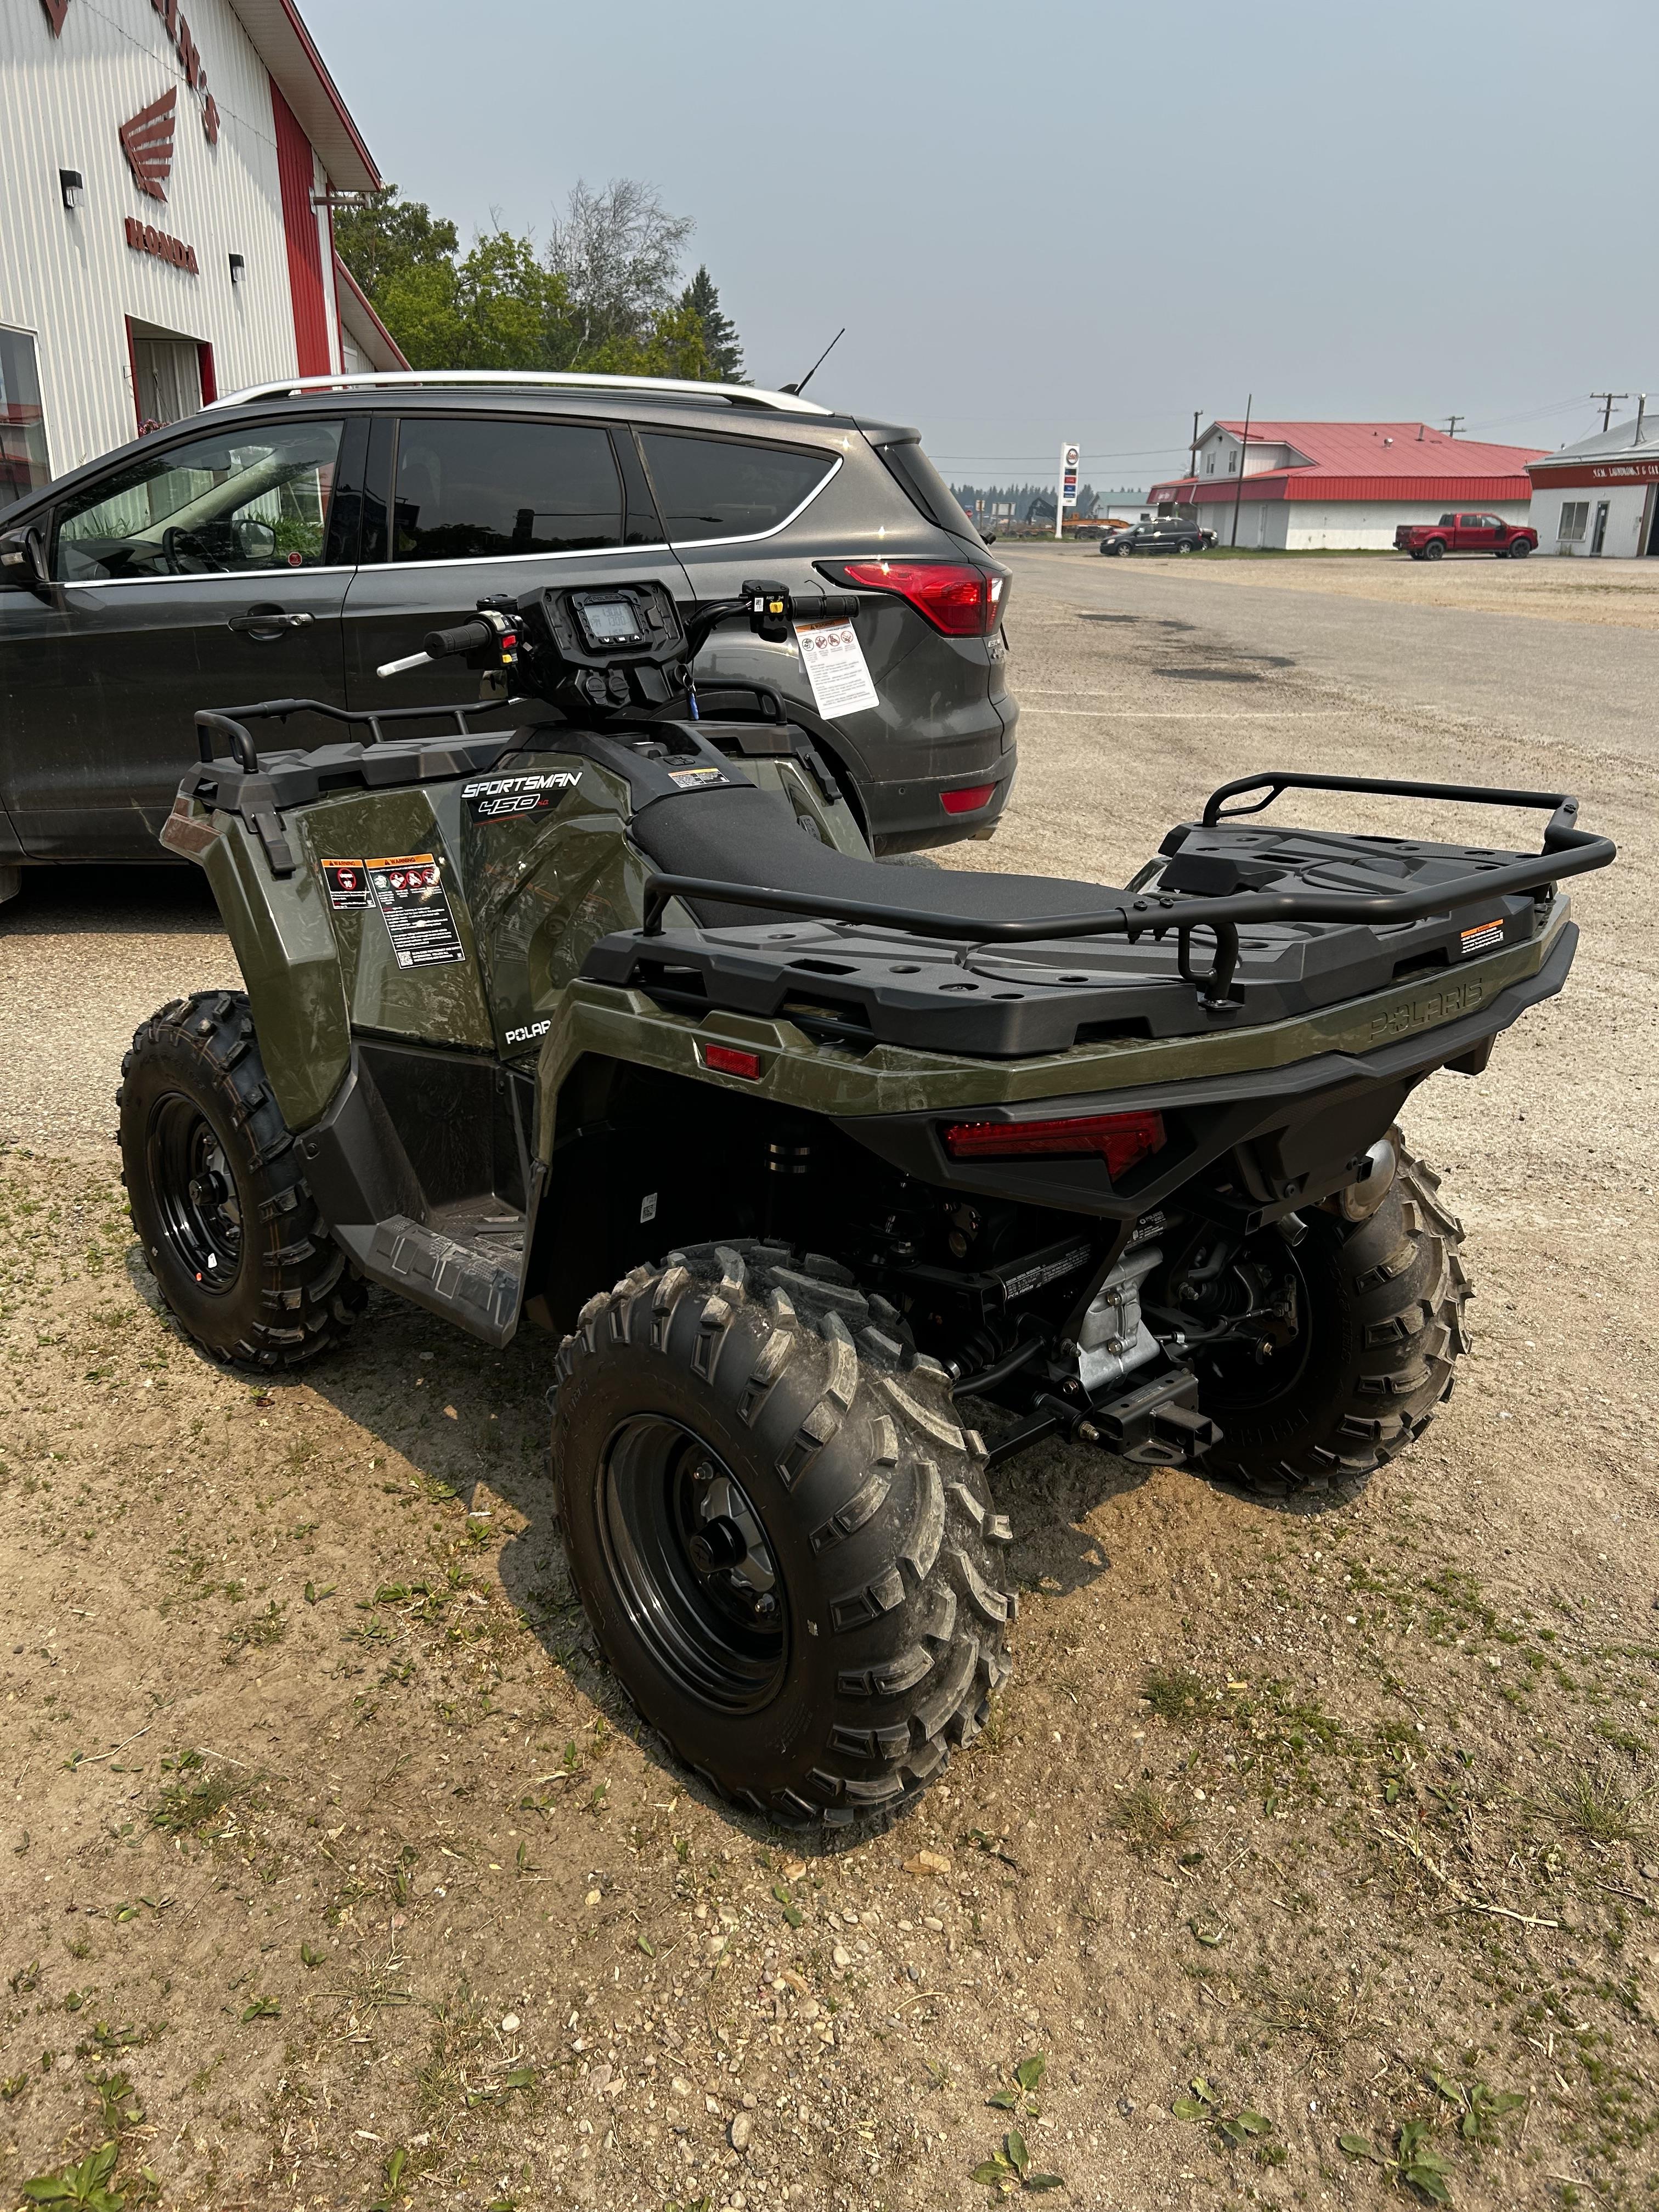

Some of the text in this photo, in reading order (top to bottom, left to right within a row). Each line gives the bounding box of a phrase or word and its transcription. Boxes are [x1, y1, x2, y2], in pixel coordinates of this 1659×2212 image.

[125, 216, 200, 275] HONDA
[461, 772, 583, 798] SPORTSMAN
[478, 793, 541, 815] 450
[1367, 978, 1483, 1043] POLARIS
